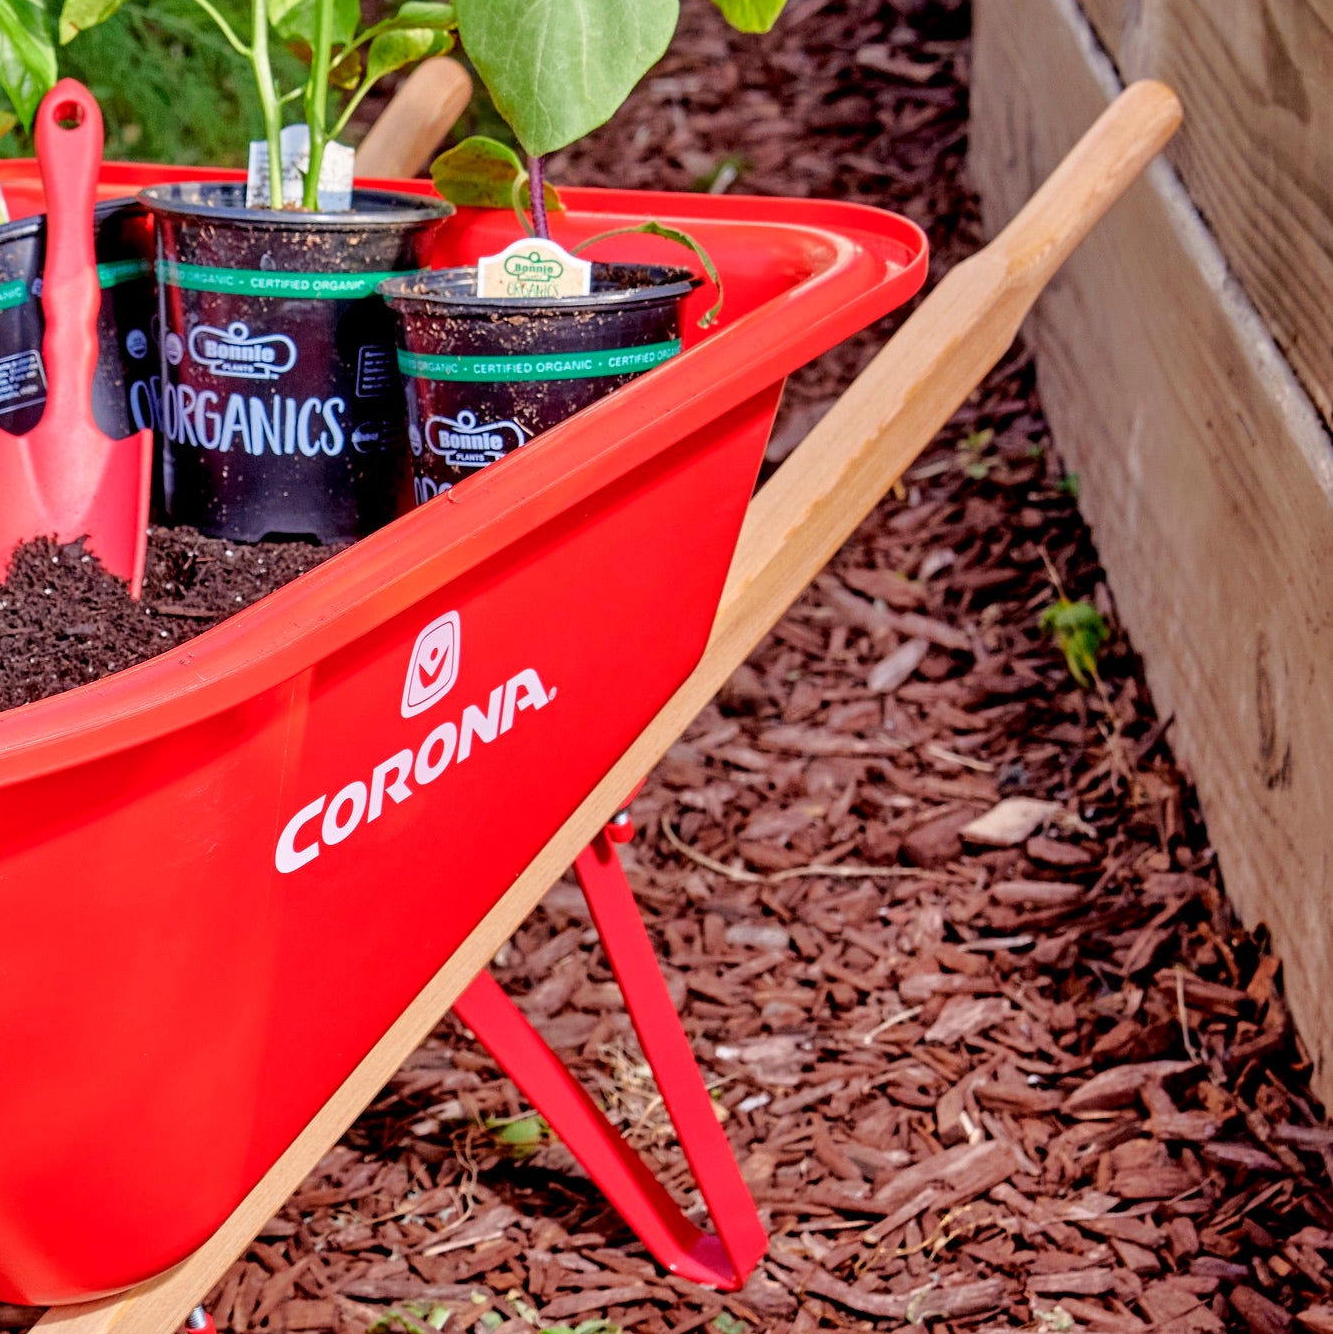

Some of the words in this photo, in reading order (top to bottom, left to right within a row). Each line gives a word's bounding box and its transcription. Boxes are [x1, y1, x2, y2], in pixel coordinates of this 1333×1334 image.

[514, 263, 554, 274] Bonnie
[249, 277, 309, 292] CERTIFIED
[312, 278, 365, 293] ORGANIC
[203, 339, 275, 363] Bonnie
[221, 363, 255, 374] PLANTS
[473, 362, 533, 375] CERTIFIED
[535, 358, 593, 374] ORGANIC
[607, 351, 655, 369] CERTIFIED
[165, 382, 346, 457] ORGANICS
[437, 429, 505, 451] Bonnie
[456, 452, 486, 462] PLANTS
[274, 667, 550, 875] CORONA
